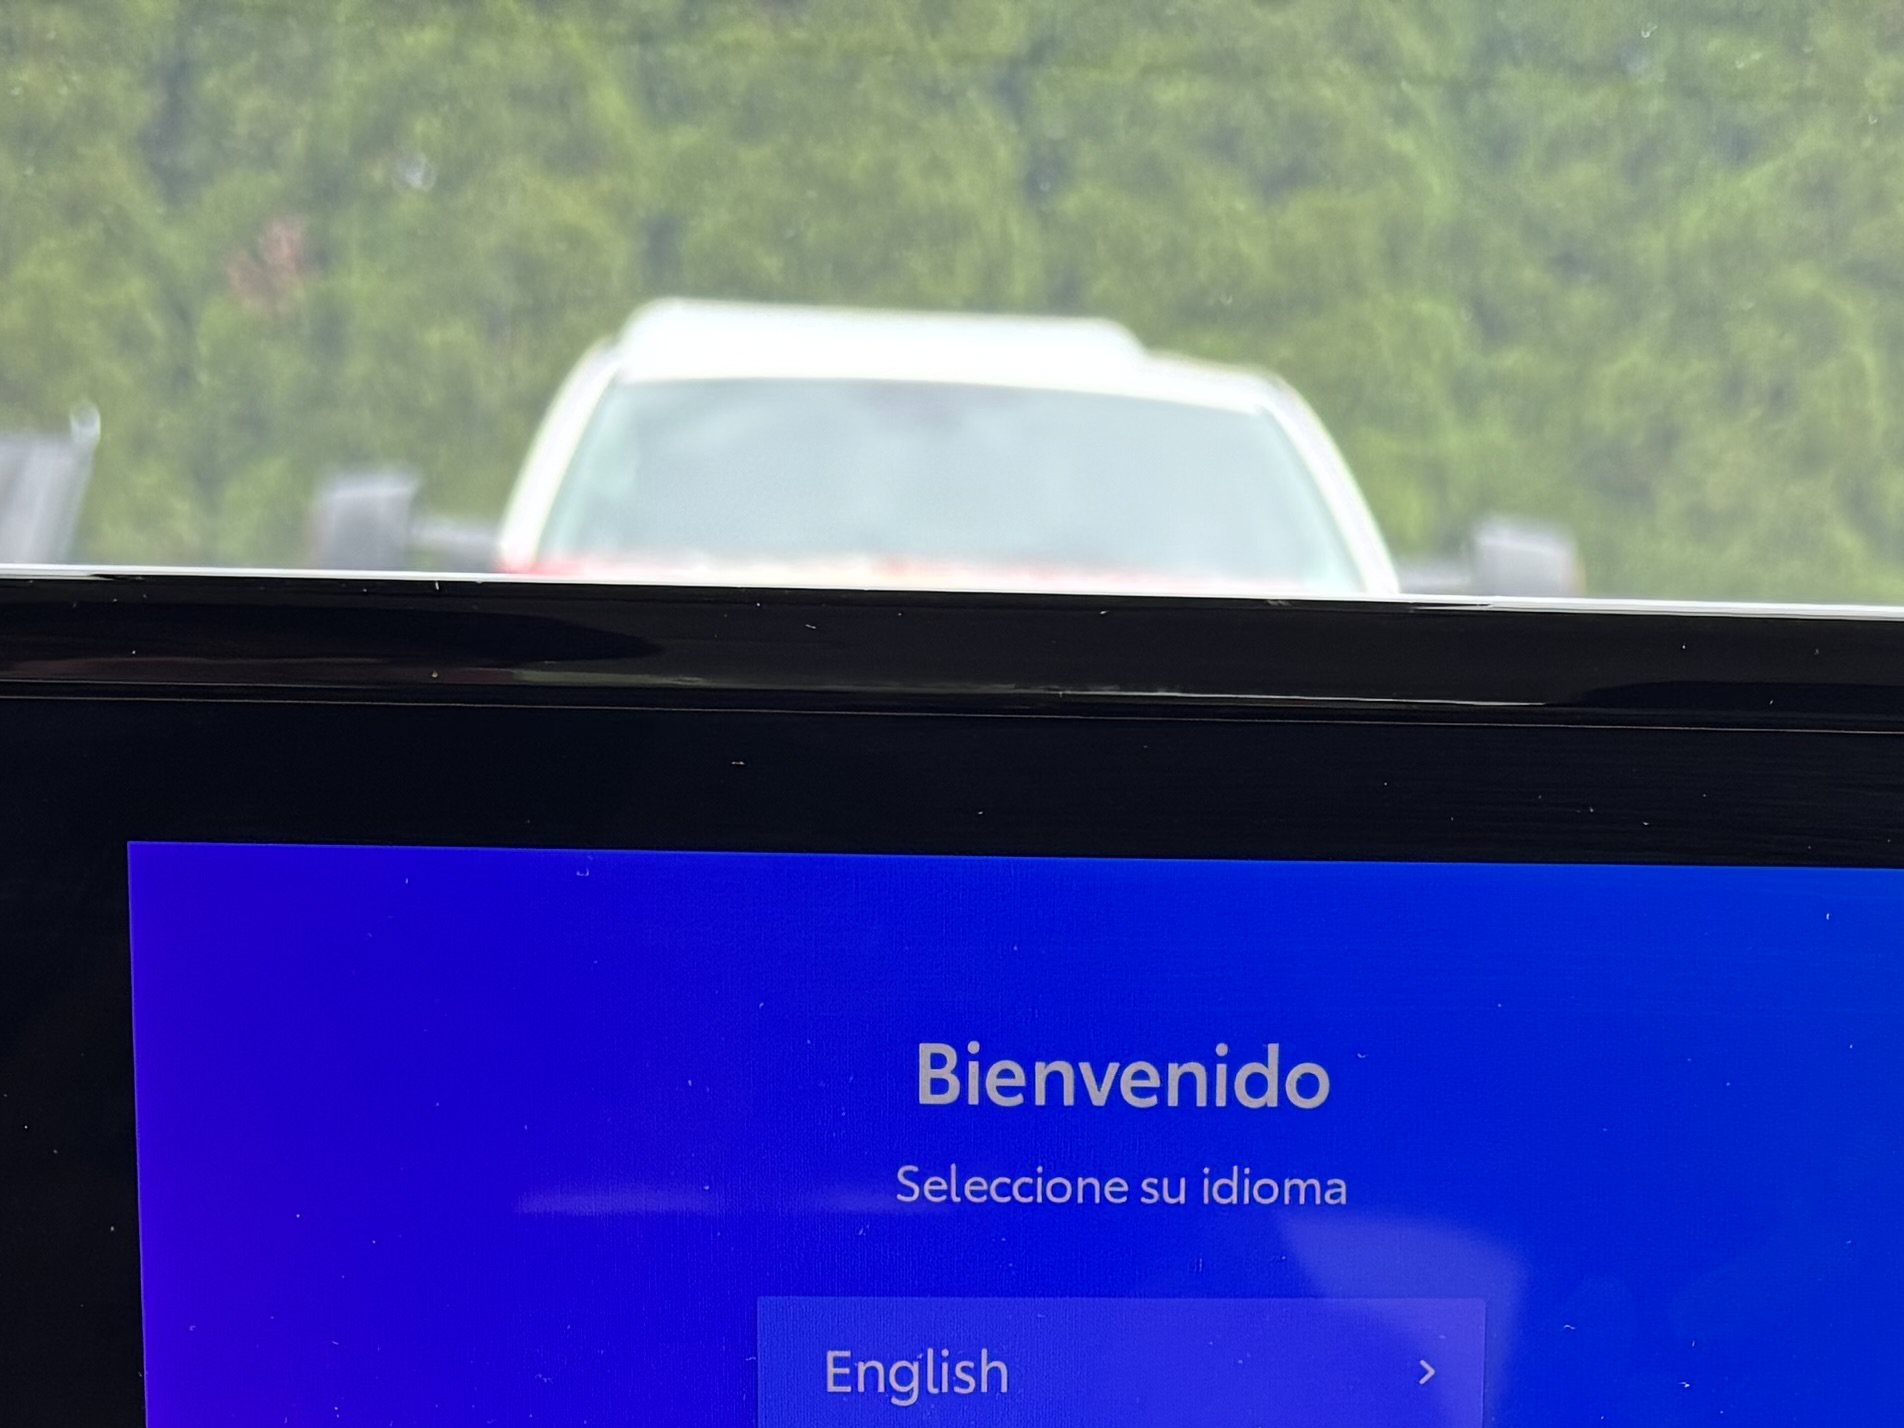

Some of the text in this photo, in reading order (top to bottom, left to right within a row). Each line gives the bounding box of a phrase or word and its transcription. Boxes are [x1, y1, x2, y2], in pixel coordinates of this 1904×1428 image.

[916, 1040, 1332, 1110] Bienvenido
[895, 1165, 1349, 1206] Seleccione su idioma
[824, 1348, 1010, 1407] English
